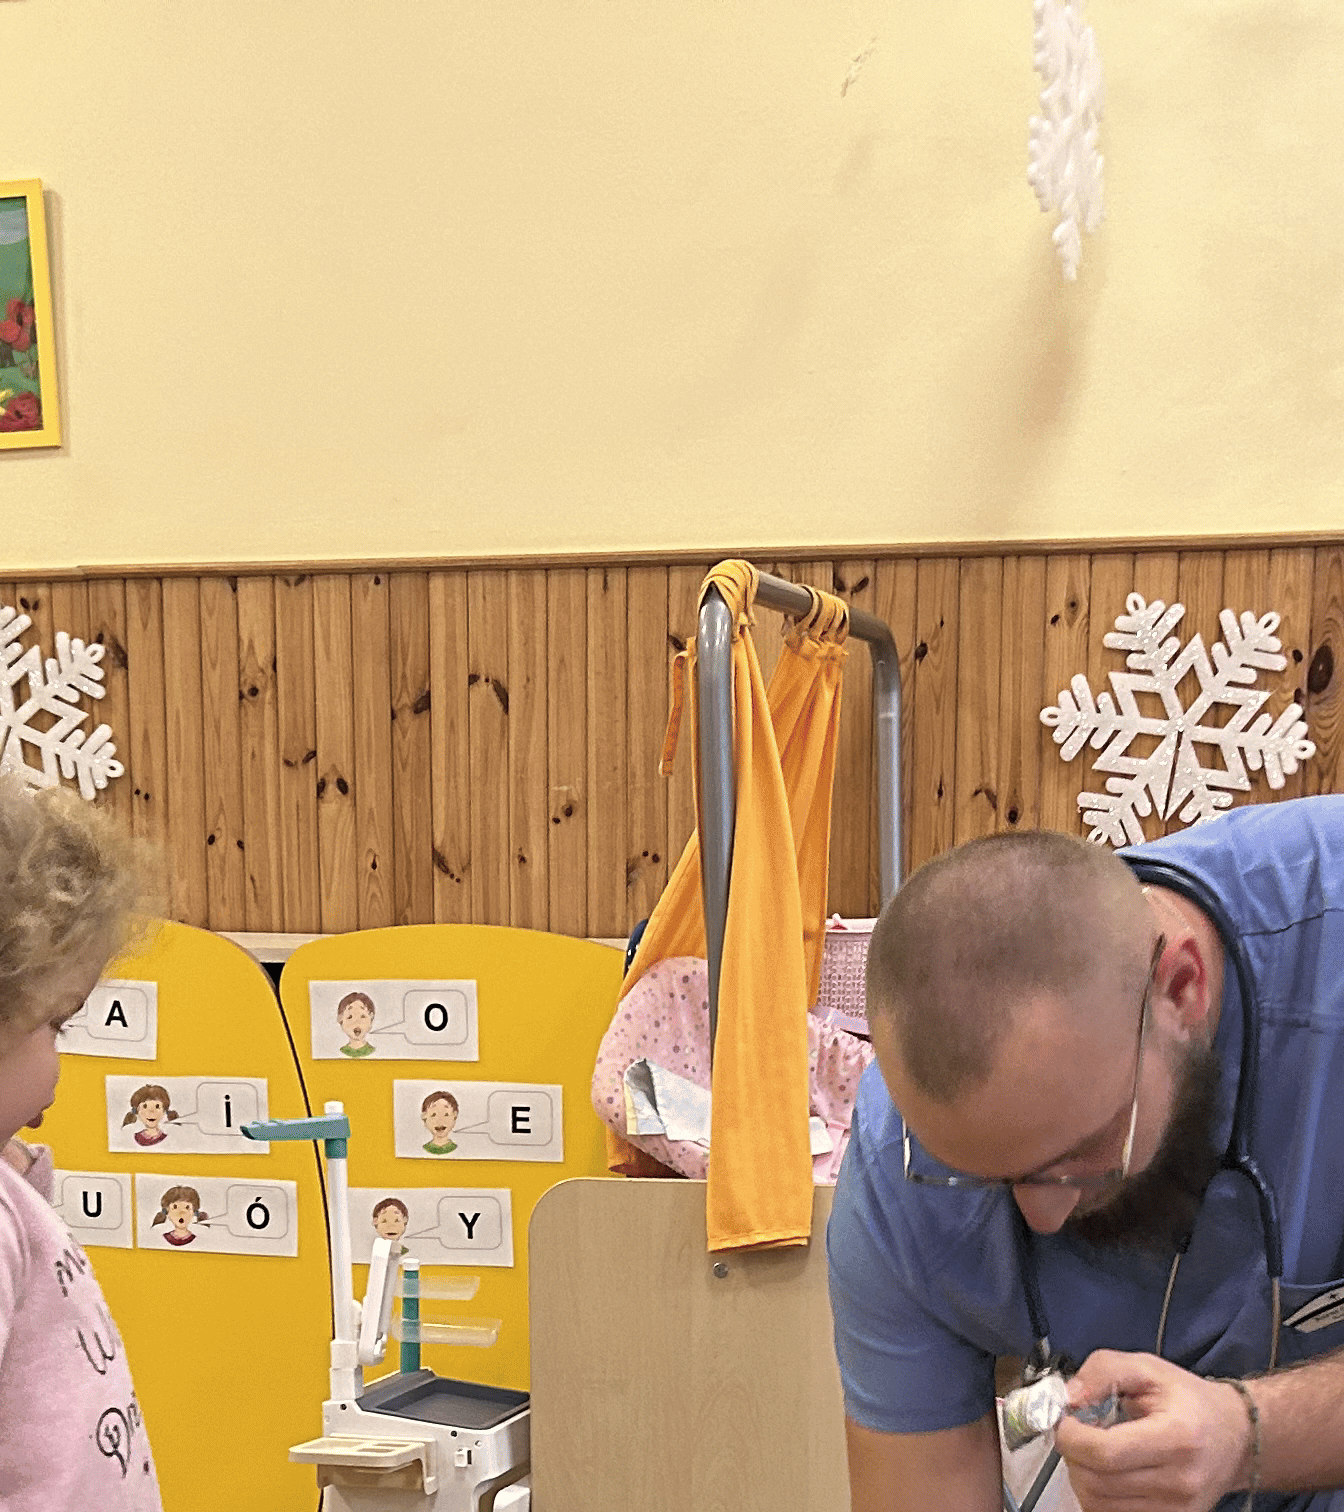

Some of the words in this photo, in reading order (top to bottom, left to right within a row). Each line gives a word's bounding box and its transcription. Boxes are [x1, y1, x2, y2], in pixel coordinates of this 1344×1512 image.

[104, 1000, 129, 1028] A
[424, 1003, 449, 1032] O
[511, 1106, 532, 1134] E
[82, 1191, 102, 1218] U
[246, 1196, 270, 1230] Ó
[457, 1212, 482, 1240] Y
